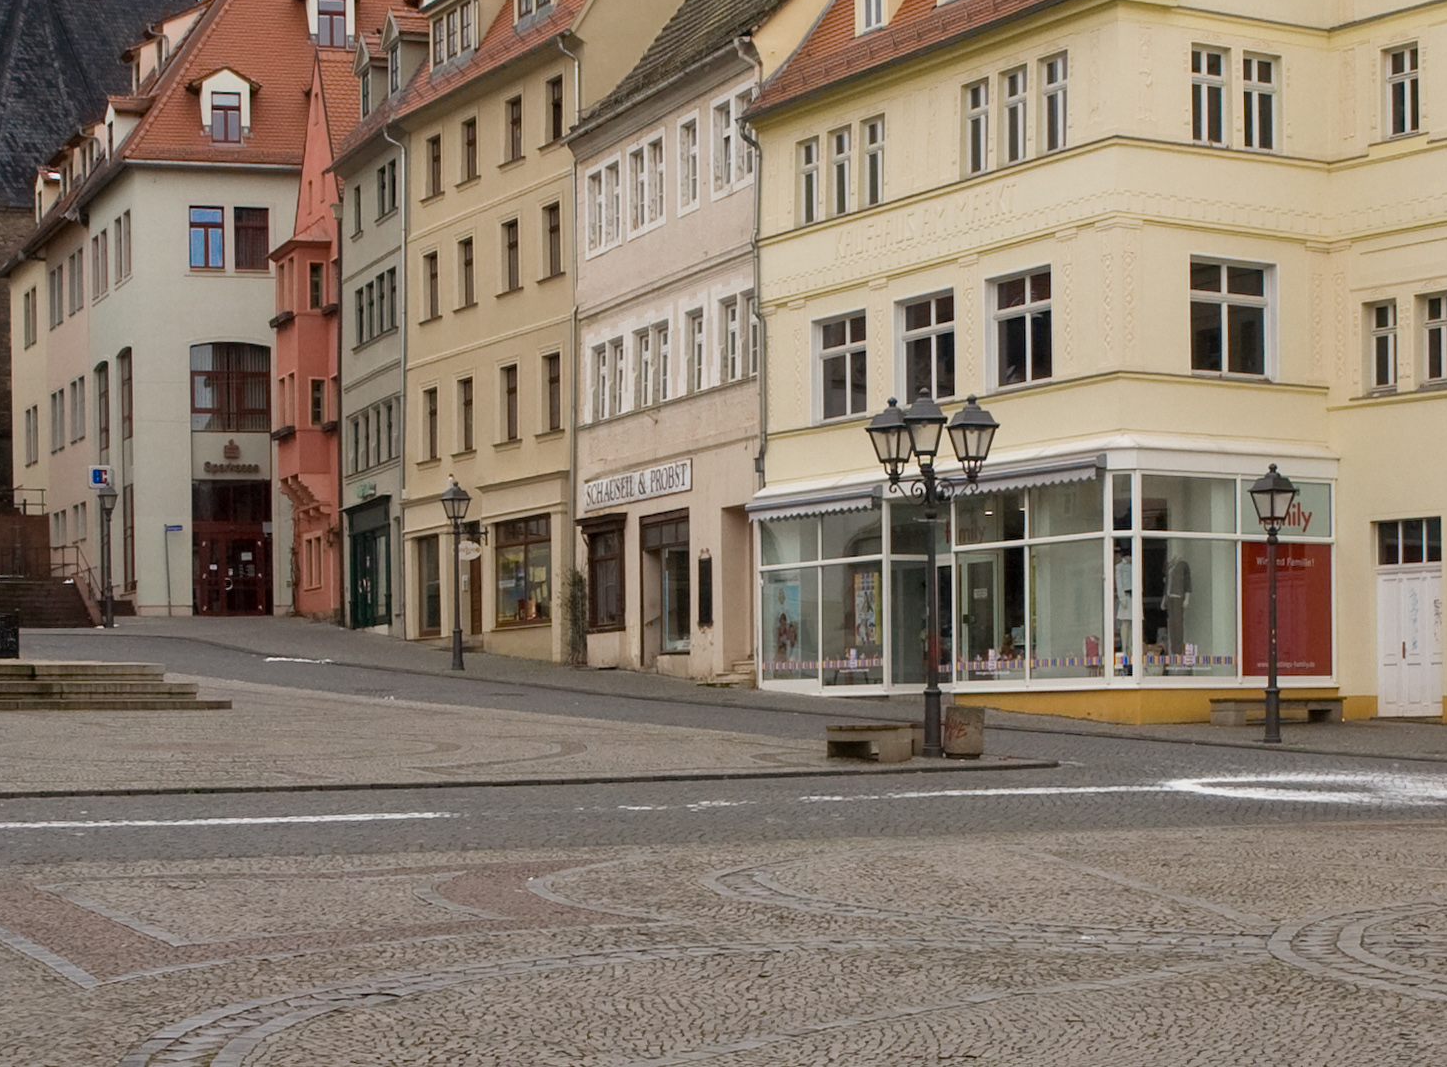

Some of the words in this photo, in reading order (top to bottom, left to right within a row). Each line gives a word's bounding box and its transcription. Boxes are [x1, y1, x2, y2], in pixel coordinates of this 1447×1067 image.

[586, 474, 634, 506] SCHAUSEIL
[637, 472, 646, 495] &
[650, 463, 687, 493] PROBST
